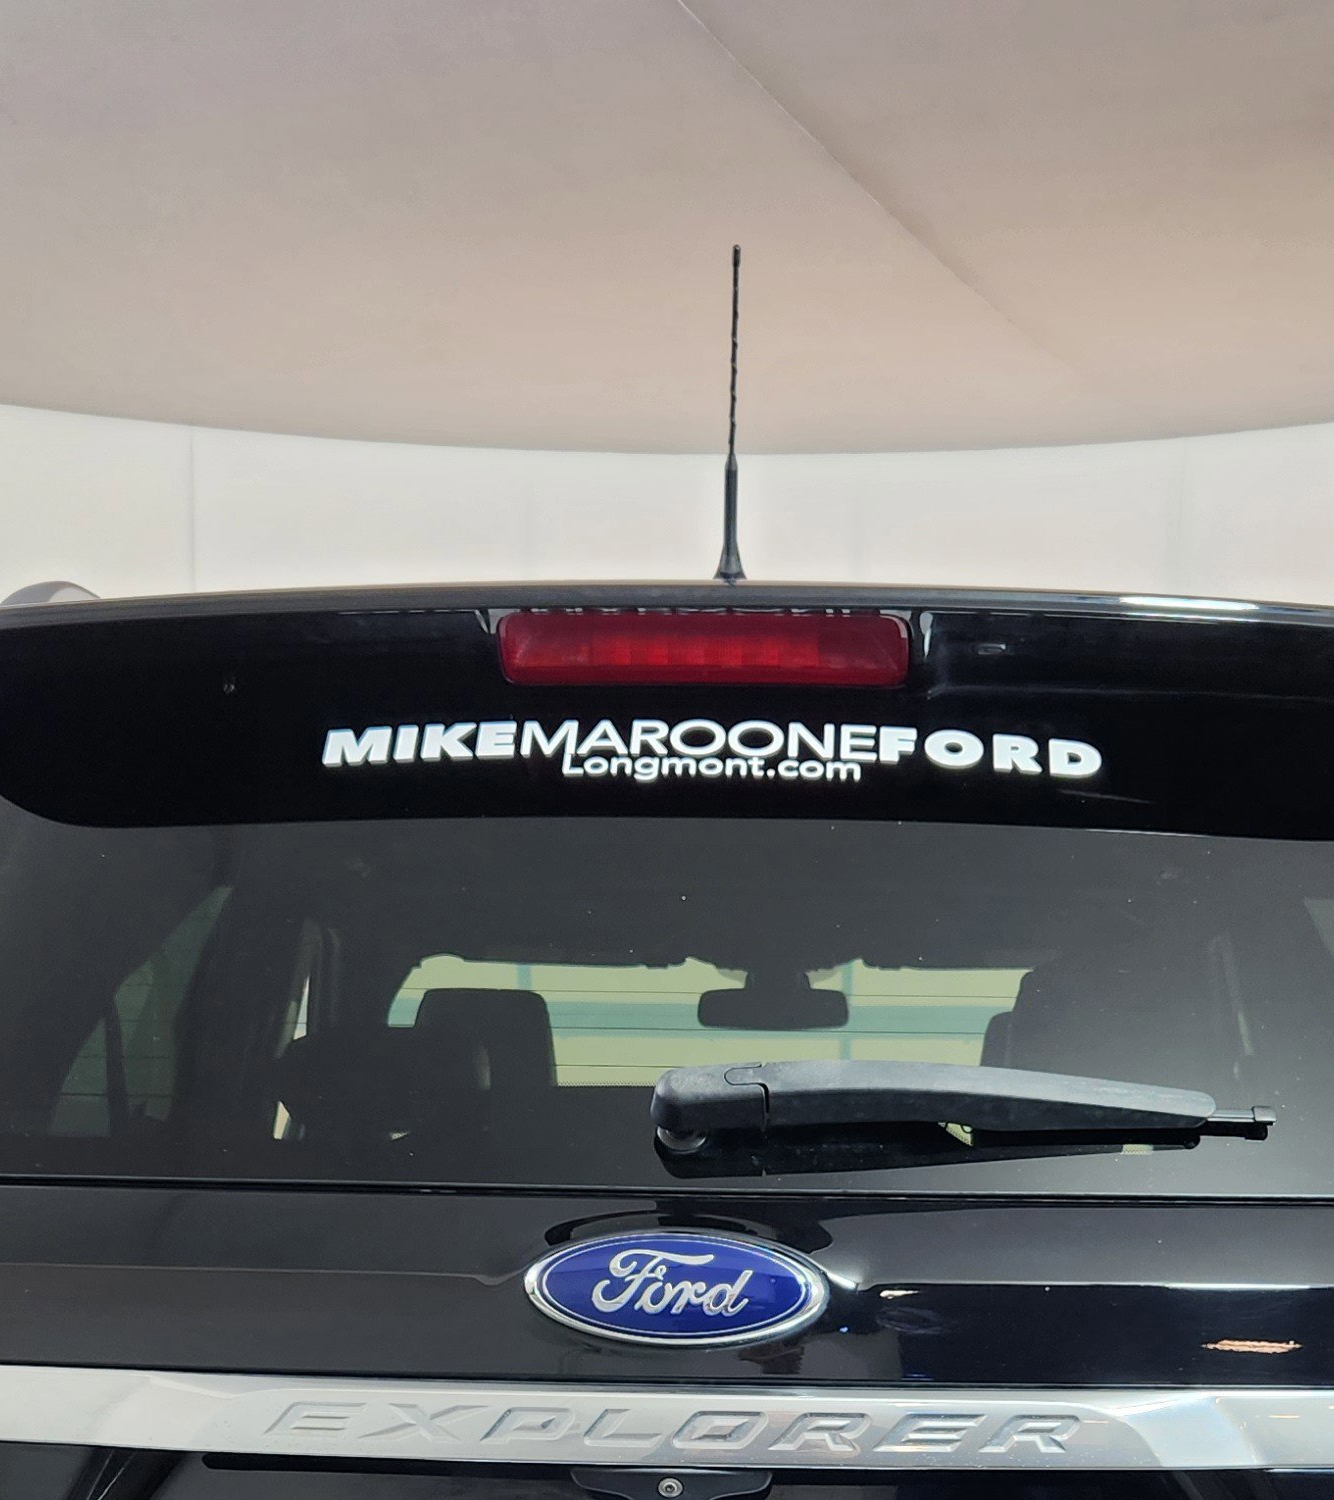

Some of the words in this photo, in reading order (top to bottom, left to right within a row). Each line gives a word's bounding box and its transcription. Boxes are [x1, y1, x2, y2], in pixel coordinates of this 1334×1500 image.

[561, 753, 862, 783] Longmont.com
[591, 1248, 752, 1317] Ford
[265, 1401, 1081, 1454] EXPLORER
